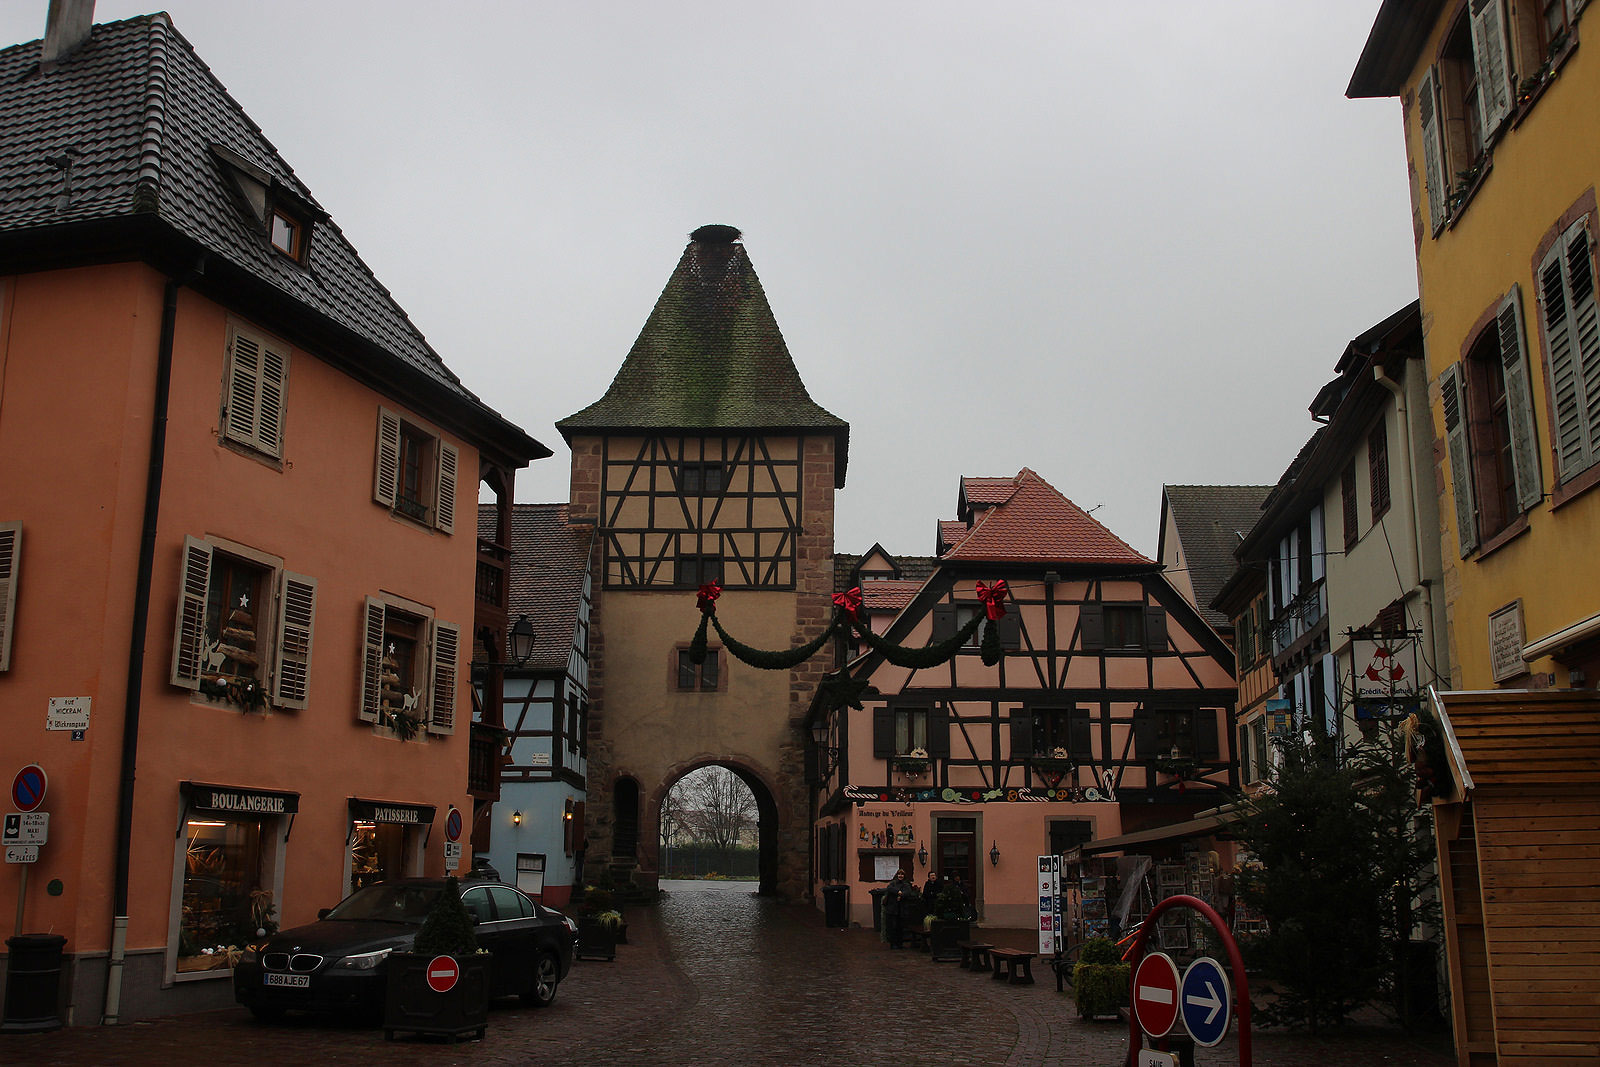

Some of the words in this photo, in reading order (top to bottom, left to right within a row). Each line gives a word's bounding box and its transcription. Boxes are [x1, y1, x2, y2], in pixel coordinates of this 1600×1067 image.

[1360, 687, 1382, 695] Crédit
[75, 731, 81, 739] 2
[211, 792, 285, 813] BOULANGERIE
[374, 807, 419, 823] PATISSERIE
[15, 854, 36, 862] PLACES
[270, 975, 283, 985] 688
[284, 976, 297, 985] AJE
[298, 977, 309, 986] 67
